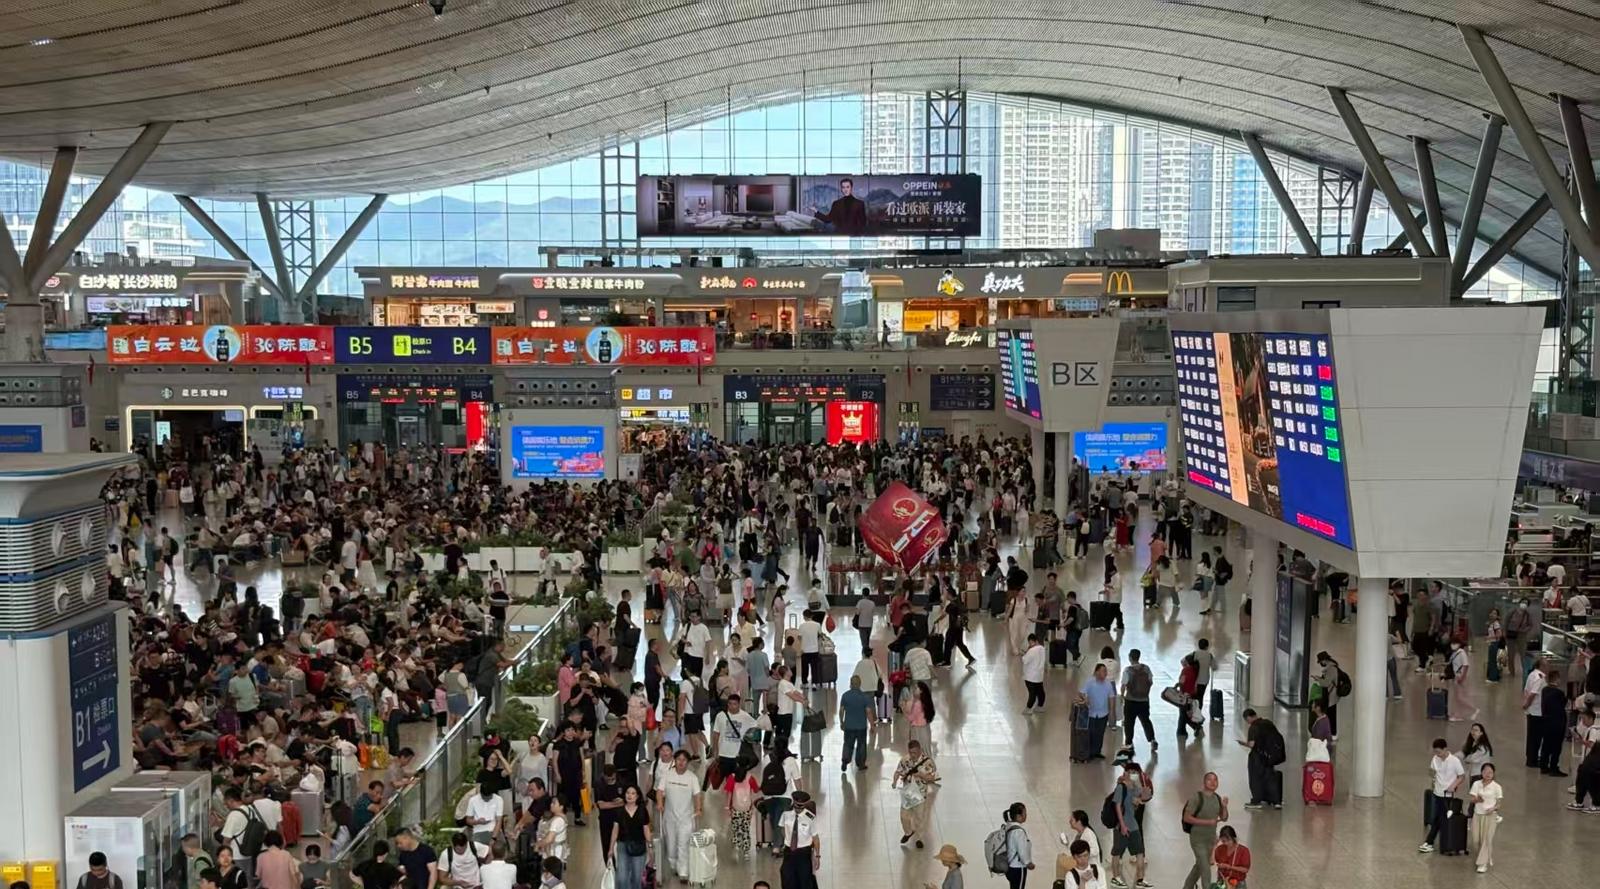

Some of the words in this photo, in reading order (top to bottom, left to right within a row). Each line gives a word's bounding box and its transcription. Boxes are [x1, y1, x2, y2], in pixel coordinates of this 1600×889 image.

[902, 181, 938, 190] OPPEIN
[886, 201, 930, 216] 看过欧派
[933, 201, 966, 216] 再装家
[980, 272, 1025, 293] 真功夫
[349, 337, 373, 355] B5
[453, 337, 478, 355] B4
[1052, 362, 1100, 386] B区
[346, 391, 359, 399] B5
[471, 391, 483, 399] B4
[735, 390, 748, 400] B3
[862, 390, 875, 400] B2
[75, 705, 91, 748] B1
